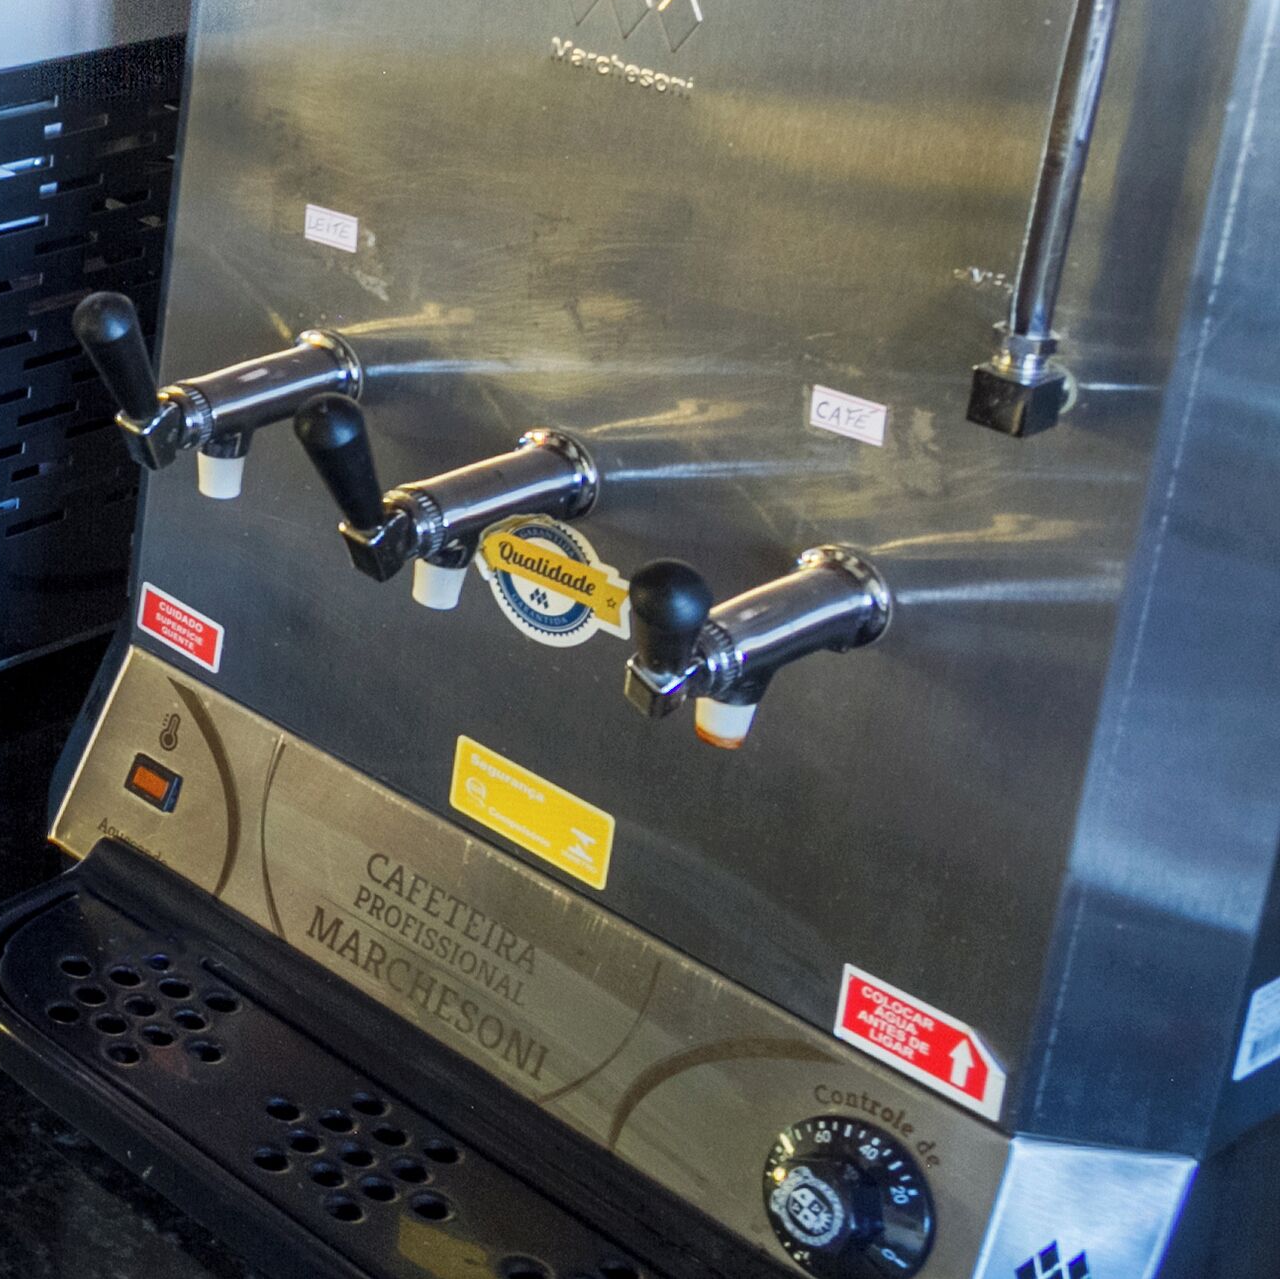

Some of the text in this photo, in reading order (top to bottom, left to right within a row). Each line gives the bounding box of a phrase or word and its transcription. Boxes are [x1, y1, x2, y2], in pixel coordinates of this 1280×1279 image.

[816, 401, 880, 430] CAFÉ
[498, 540, 597, 597] Qualidade
[158, 601, 204, 634] CUIDADO
[470, 753, 546, 804] Segurança
[366, 852, 538, 975] CAFETEIRA
[352, 884, 526, 1007] PROFISSIONAL
[305, 904, 550, 1081] MARCHESONI
[861, 985, 935, 1032] COLOCAR
[857, 1010, 930, 1056] ANTES DE
[868, 1027, 914, 1061] LIGAR
[813, 1083, 940, 1167] Controle de
[814, 1129, 833, 1144] 60
[858, 1144, 880, 1161] 40
[890, 1185, 910, 1205] 20
